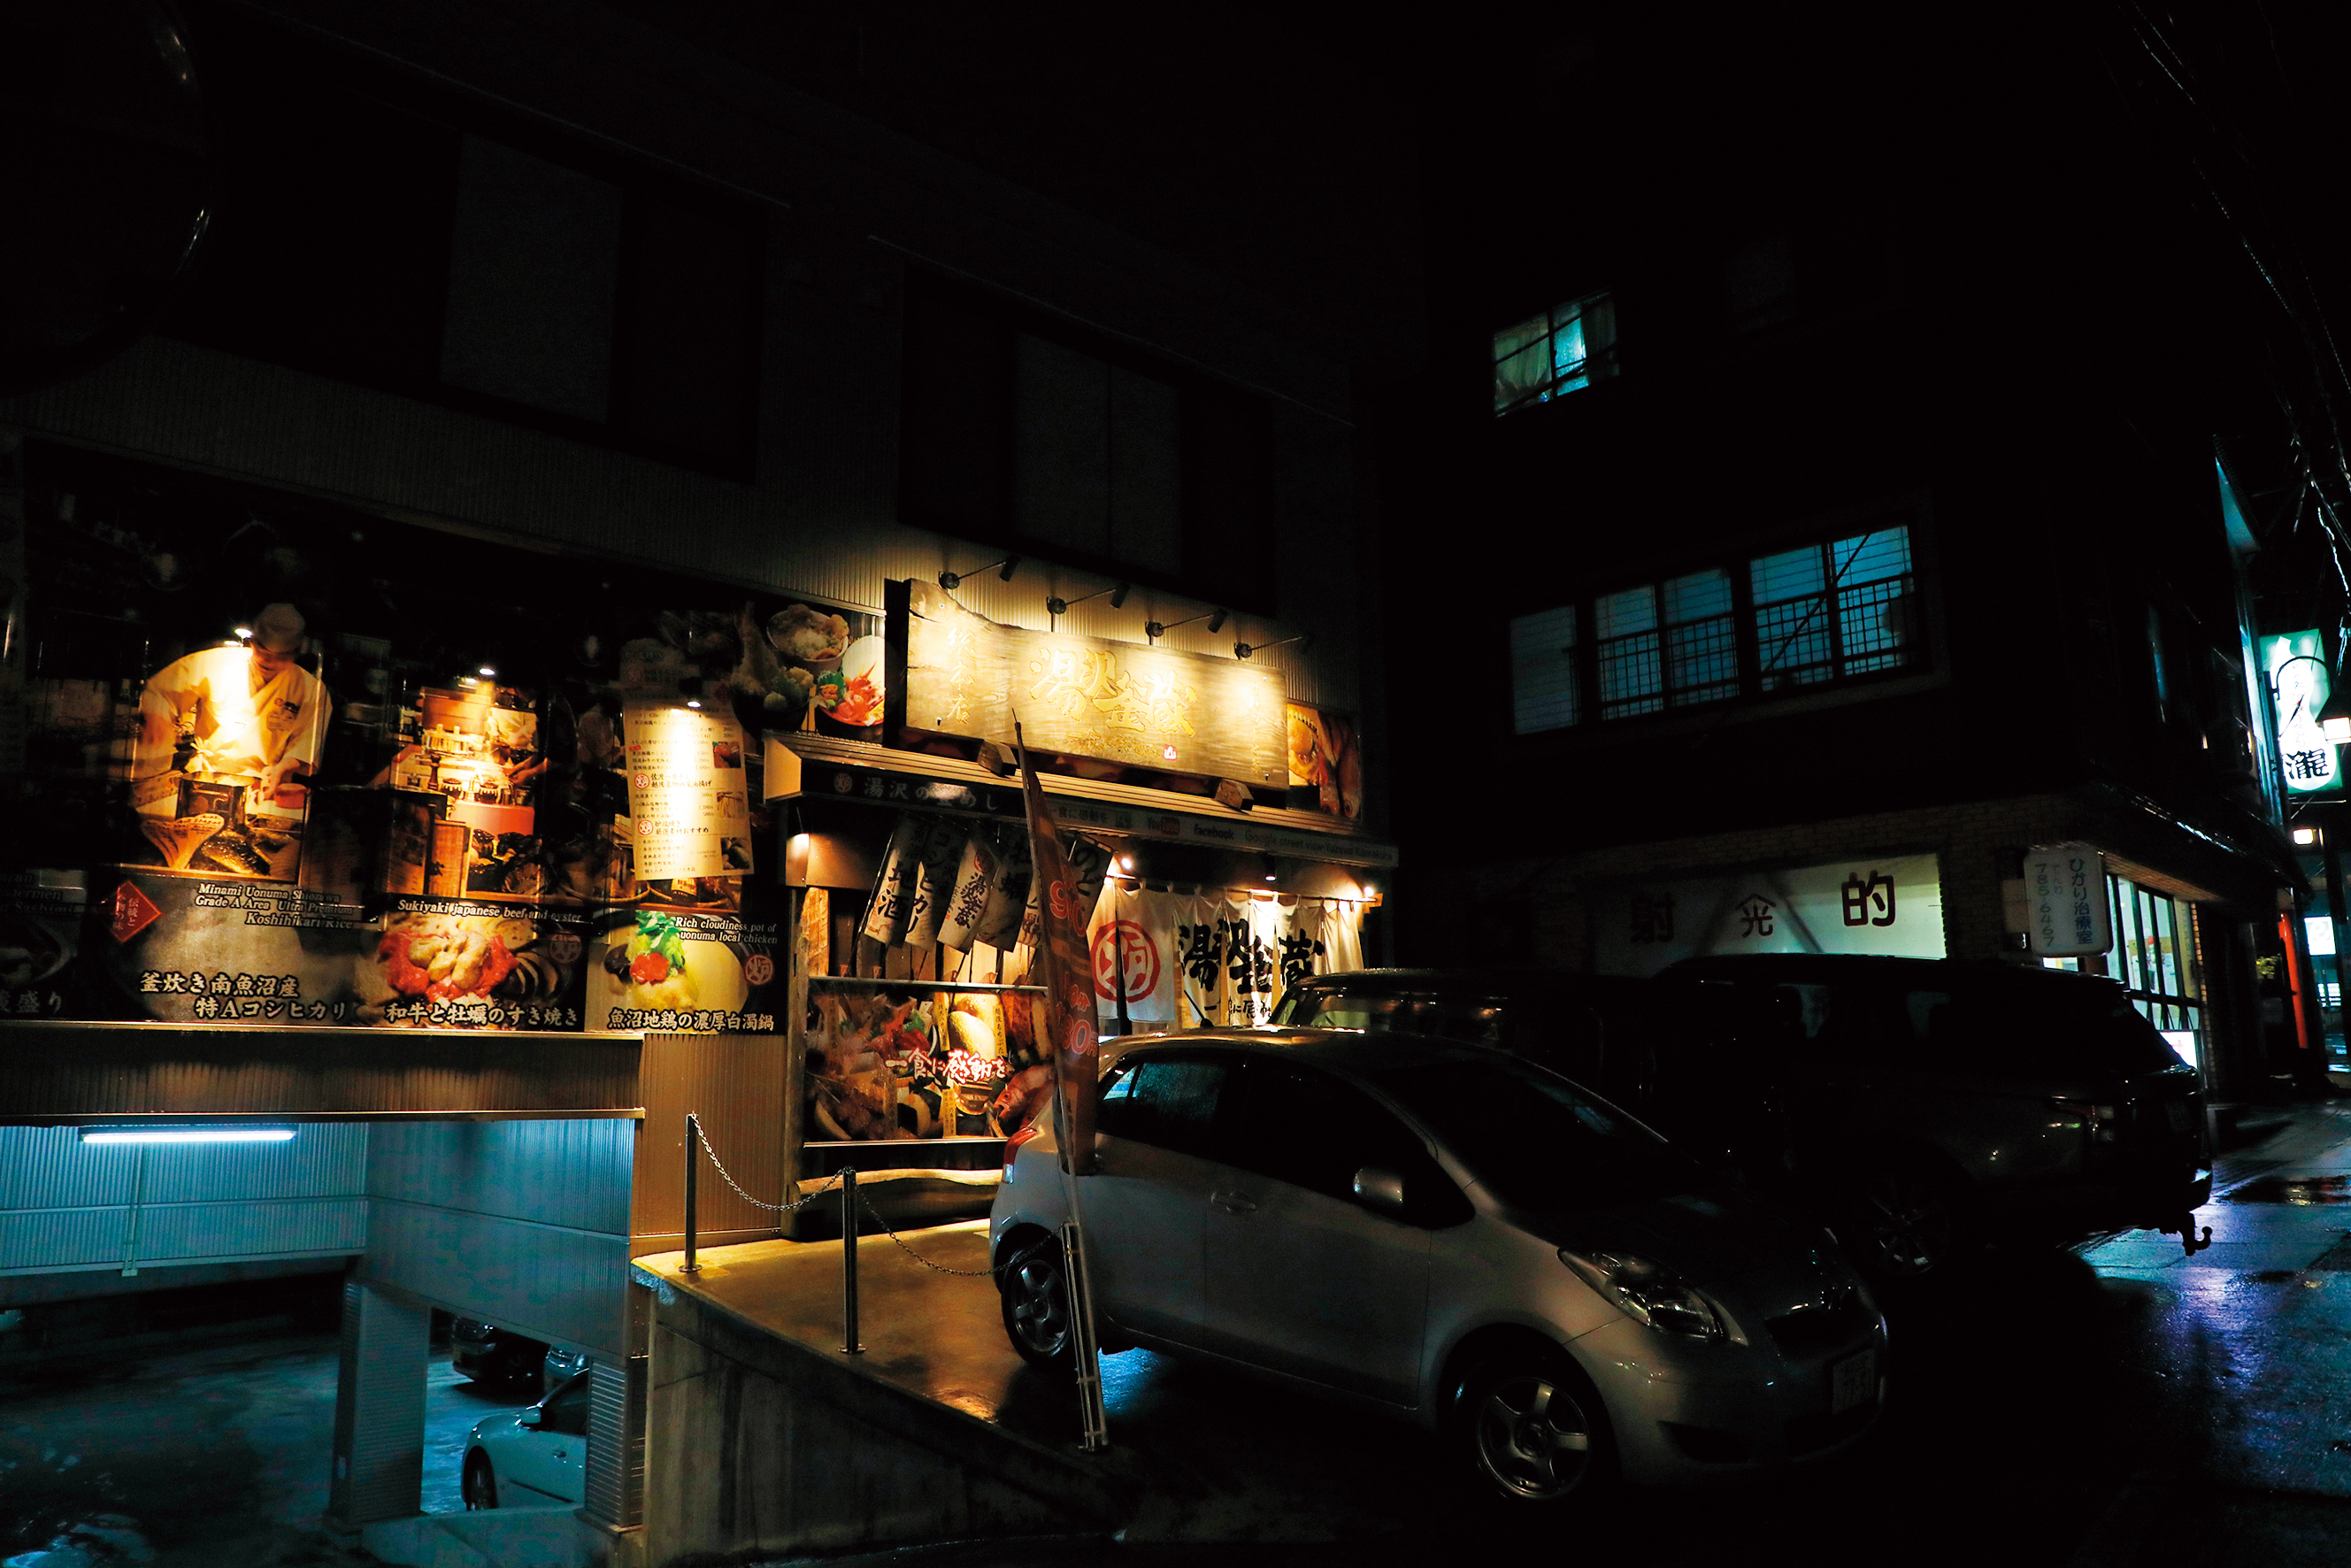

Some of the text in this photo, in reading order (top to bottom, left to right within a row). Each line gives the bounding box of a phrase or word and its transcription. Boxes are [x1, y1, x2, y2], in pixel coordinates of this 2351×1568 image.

[864, 775, 999, 811] 湯沢のめし
[1195, 823, 1235, 842] facebook
[1244, 829, 1276, 848] Google
[198, 881, 340, 903] Minami Uonuma Shiozawa
[878, 861, 918, 922] 地酒
[2069, 857, 2093, 945] ひかり治療室
[195, 895, 354, 915] Grade A Area Ultra Premium
[397, 898, 582, 924] Sukiyaki japanese beef and oyster
[1630, 890, 1677, 944] 射
[1840, 869, 1896, 927] 的
[245, 911, 353, 929] Koshihikari Rice
[675, 916, 778, 934] Rich cloudiness pot of
[680, 931, 779, 945] uonuma local chicken
[140, 970, 301, 999] 釜炊き南魚沼産
[194, 995, 348, 1021] 特Aコシヒカリ
[385, 1002, 578, 1028] 和牛と牡蠣のすき焼き
[608, 1007, 775, 1032] 魚沼地鶏の濃厚白濁鍋
[885, 1047, 1007, 1086] 一食に感動を
